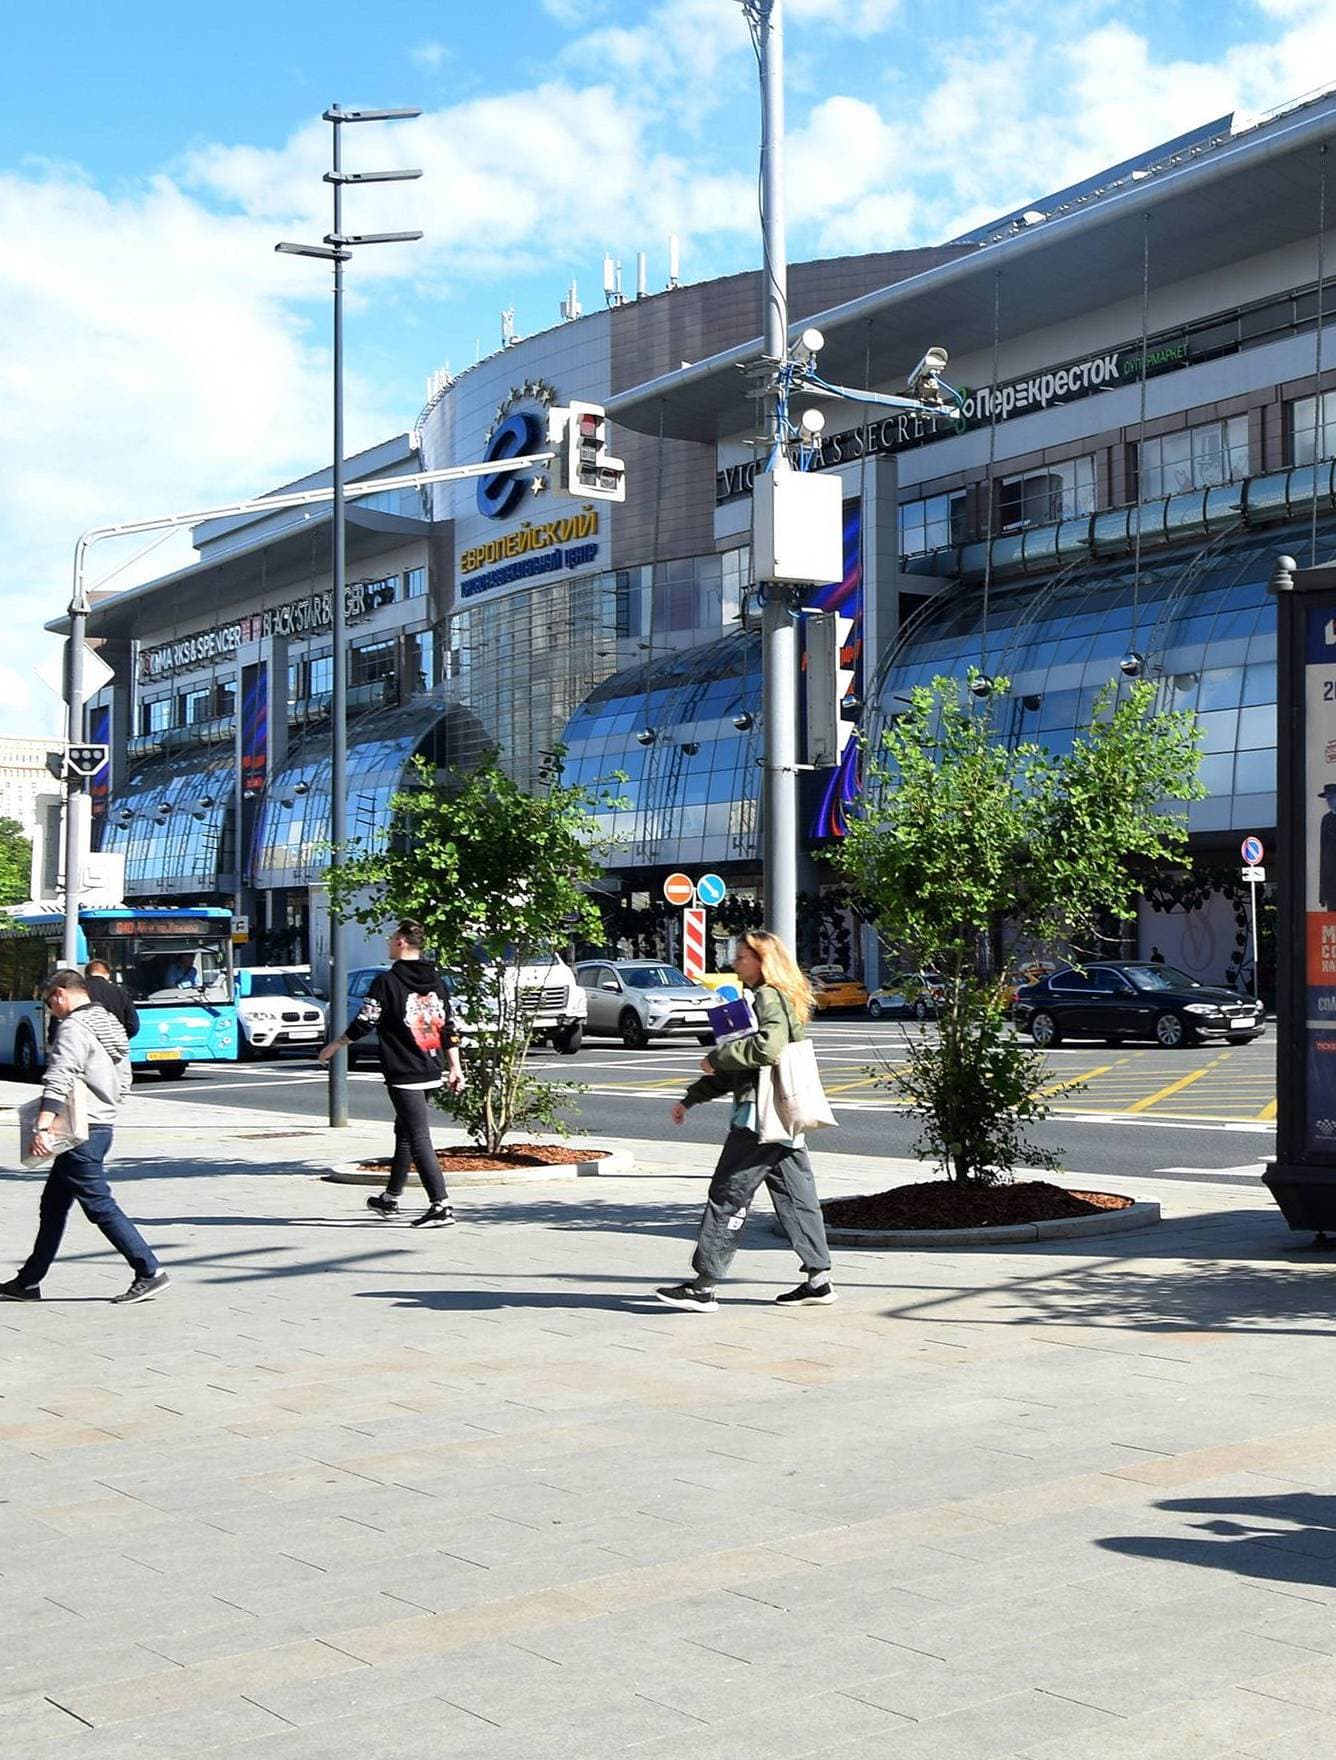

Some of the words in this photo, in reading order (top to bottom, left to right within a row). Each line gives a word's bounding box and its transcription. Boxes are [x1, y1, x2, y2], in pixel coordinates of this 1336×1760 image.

[1123, 344, 1188, 375] СУПЕРМАРКЕТ
[461, 504, 598, 574] ЕВРОПЕЙСКИЙ
[322, 583, 366, 625] BGER
[1322, 945, 1330, 958] С
